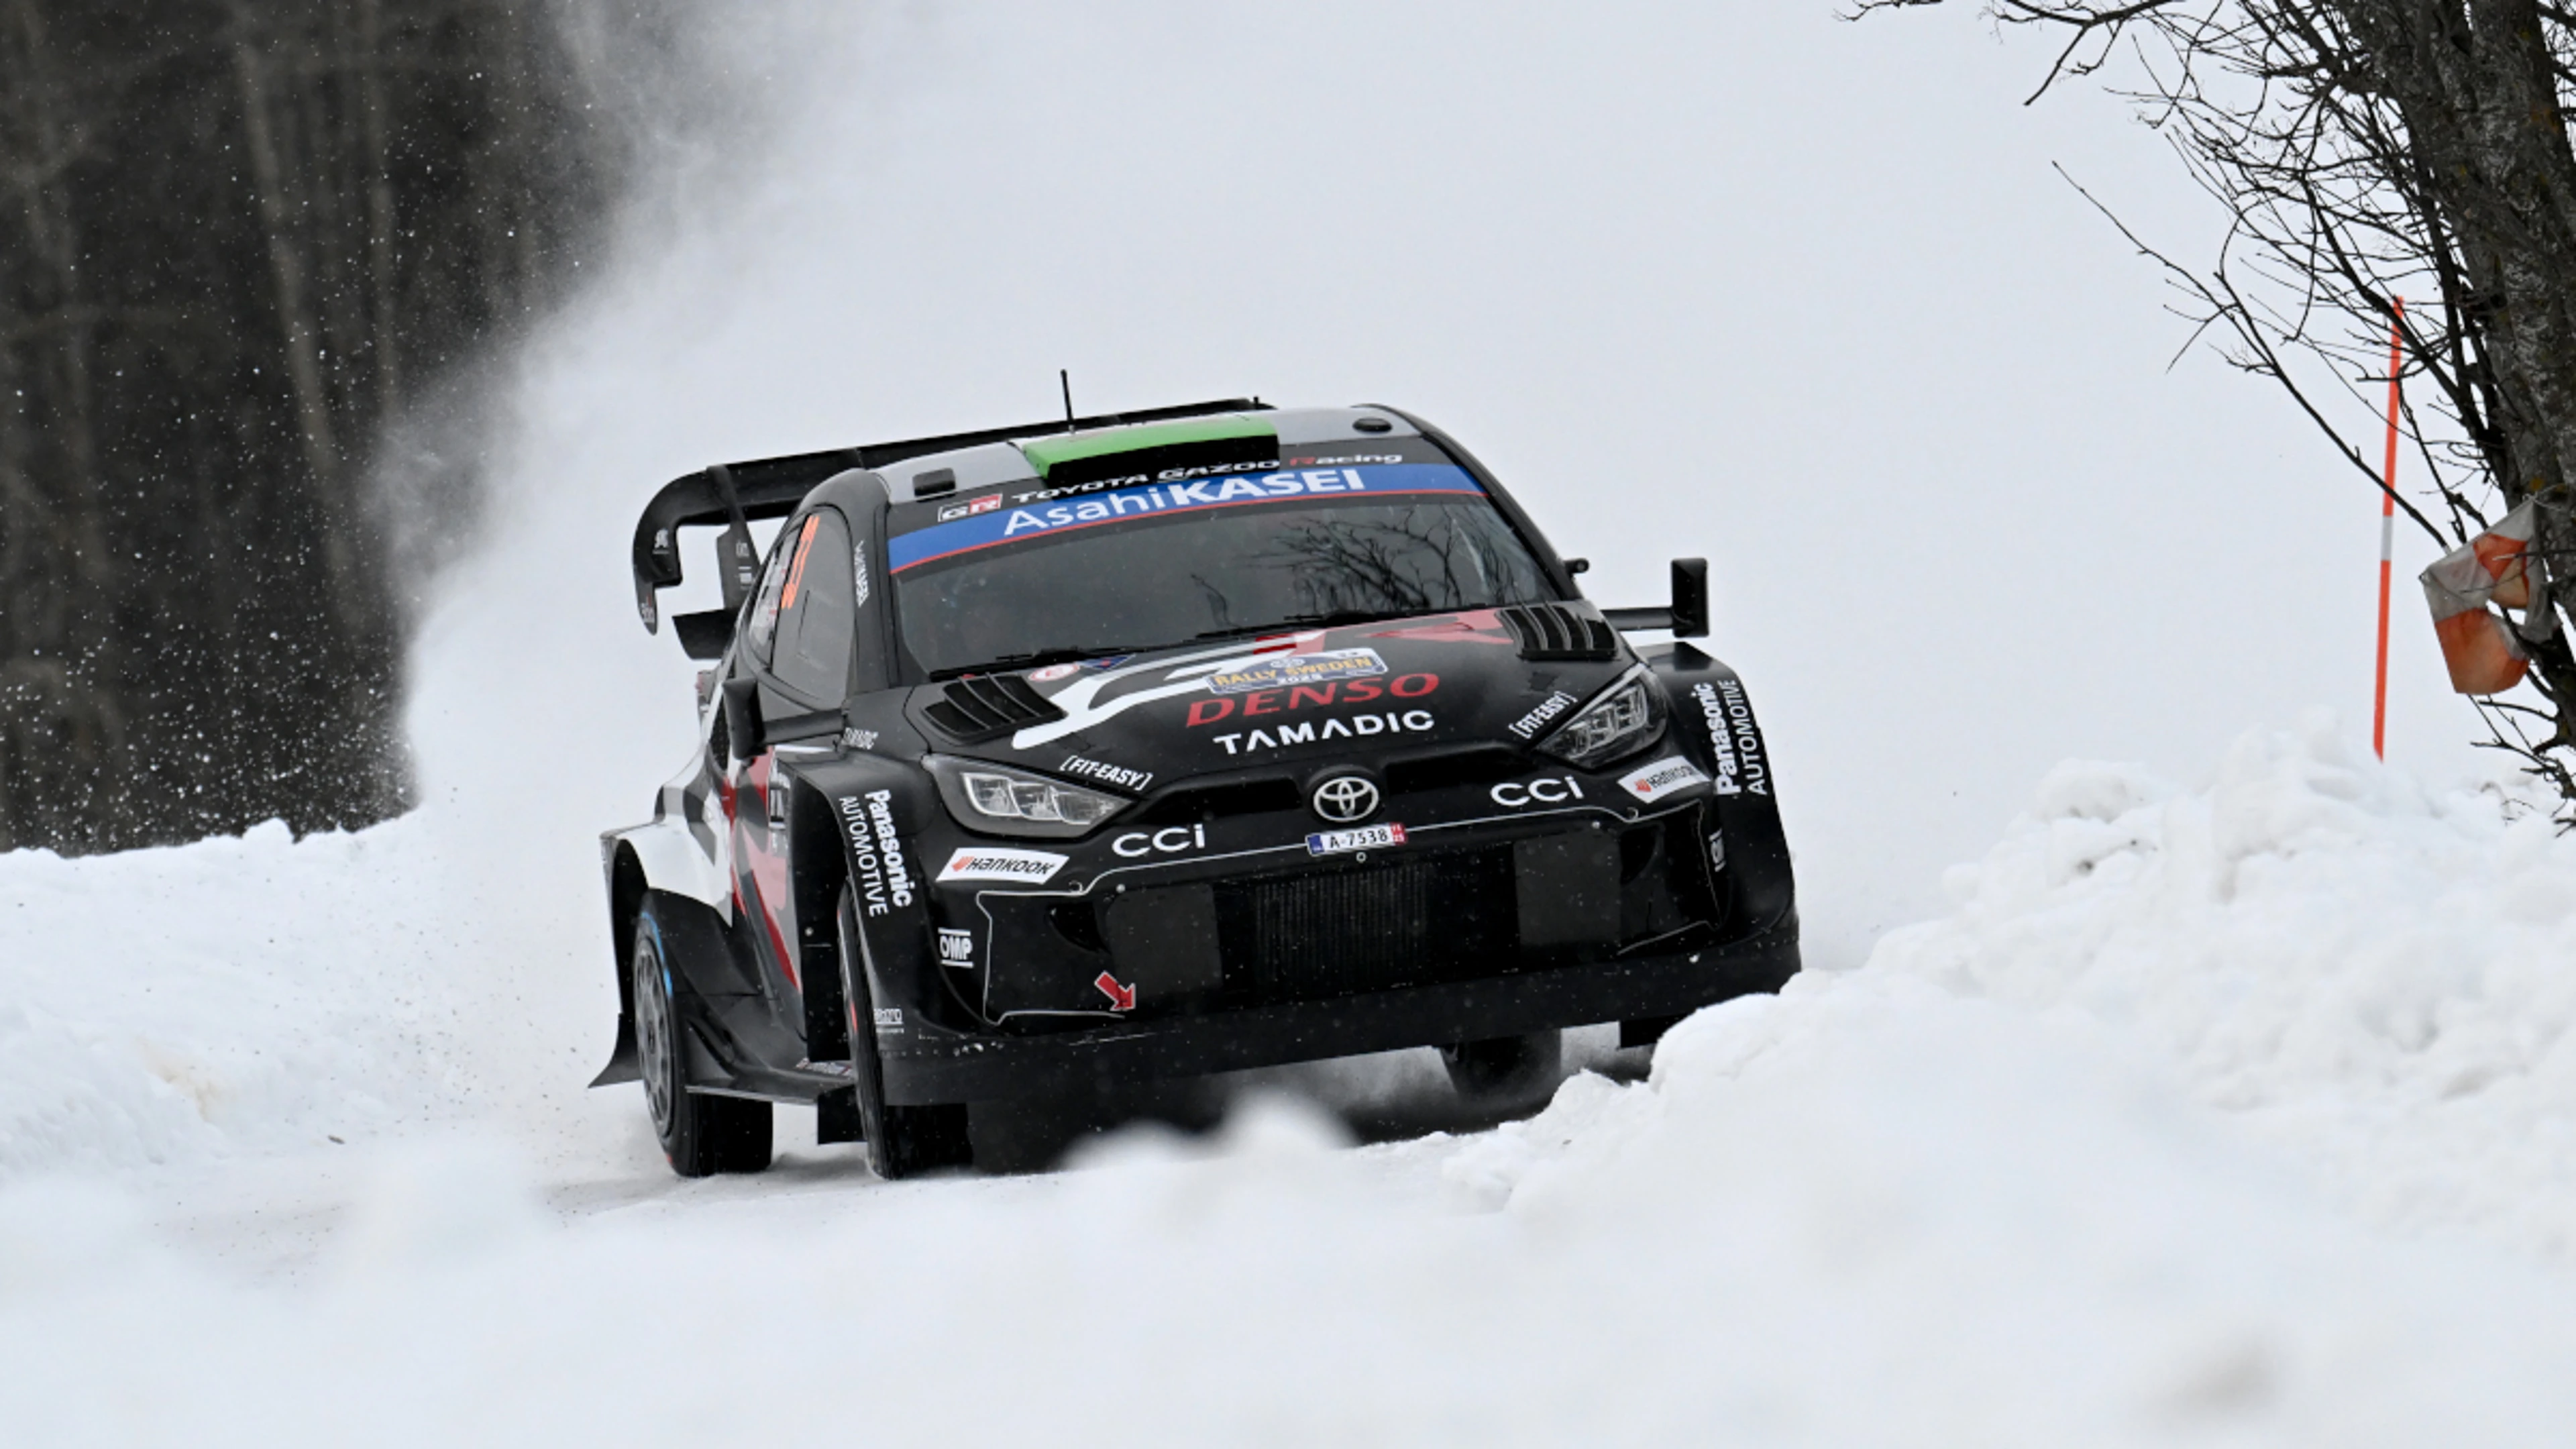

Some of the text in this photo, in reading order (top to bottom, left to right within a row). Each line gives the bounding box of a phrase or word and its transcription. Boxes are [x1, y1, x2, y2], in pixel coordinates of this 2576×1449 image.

[1011, 454, 1403, 502] TOYOTA GAZOO Racing
[1214, 669, 1277, 686] RALLY
[1285, 655, 1374, 676] SWEDEN
[1185, 673, 1440, 728] DENSO
[1212, 710, 1435, 755] TAMADIC
[1690, 681, 1741, 796] Panasonic
[1718, 680, 1769, 796] AUTOMOTIVE
[839, 796, 889, 917] AUTOMOTIVE
[865, 789, 916, 908] Panasonic
[1330, 828, 1389, 849] A-7538
[939, 935, 973, 961] OMP
